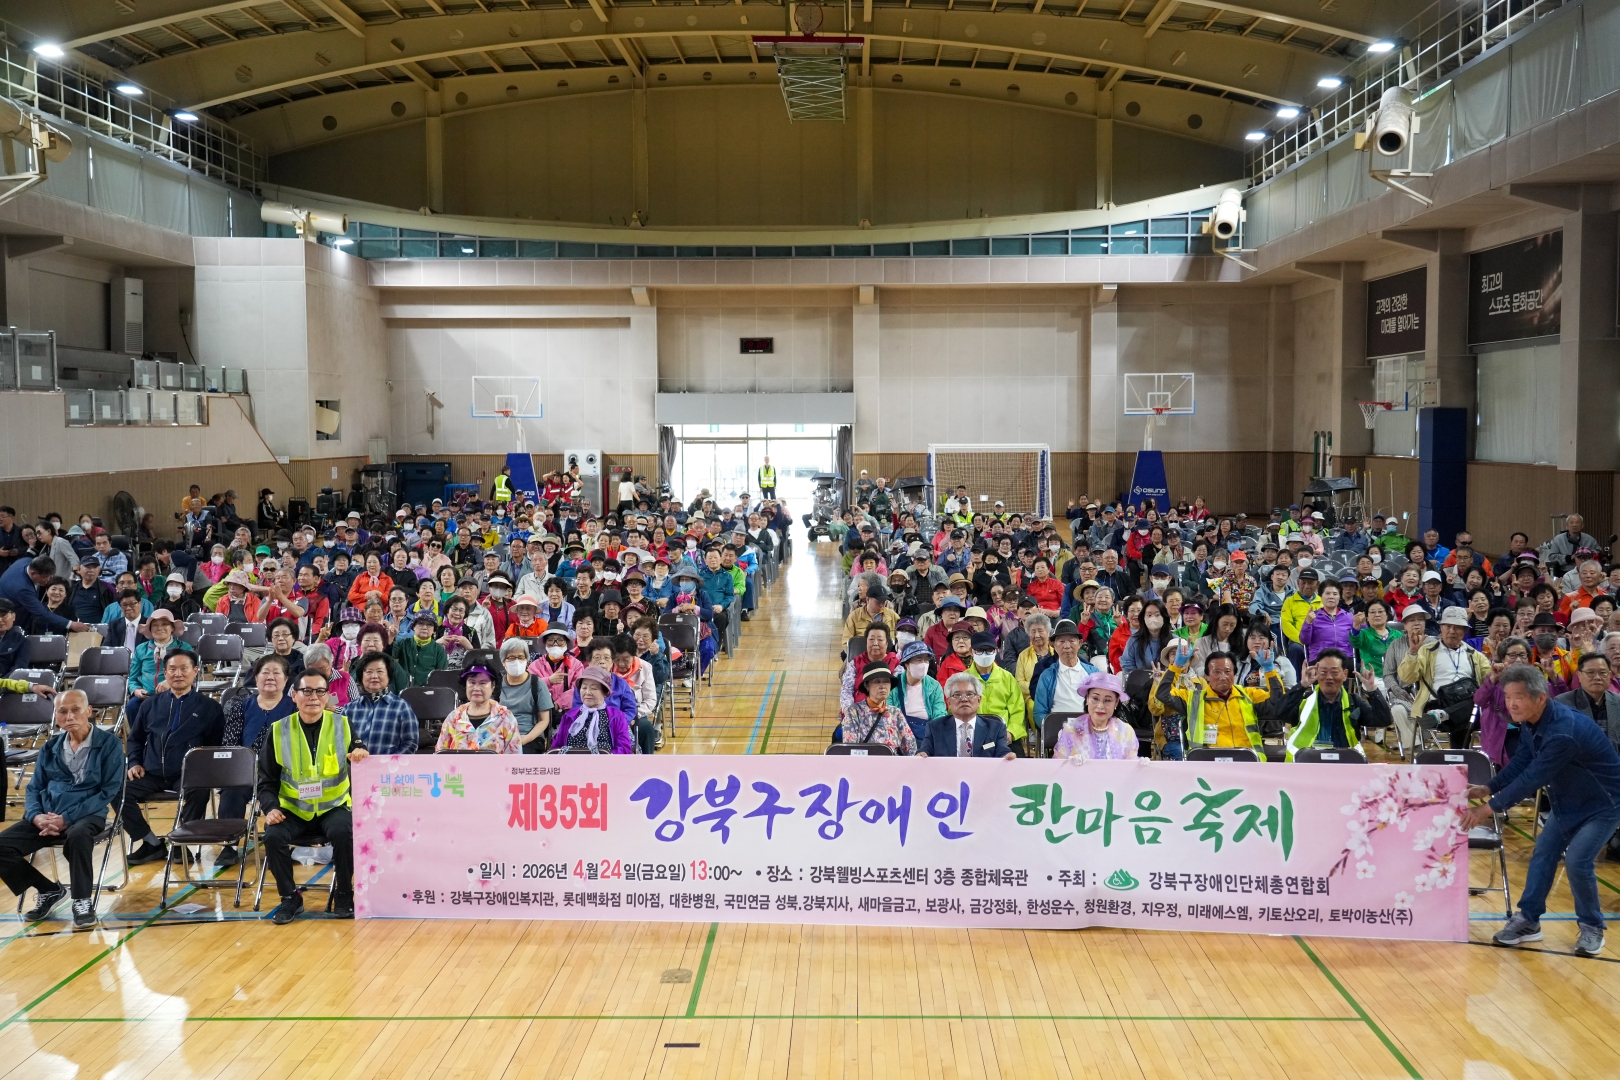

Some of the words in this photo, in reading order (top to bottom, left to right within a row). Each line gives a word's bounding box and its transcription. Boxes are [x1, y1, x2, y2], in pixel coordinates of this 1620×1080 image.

[1481, 271, 1503, 293] 최고의
[1375, 297, 1391, 315] 고객의
[1391, 292, 1408, 313] 건강한
[1488, 294, 1511, 316] 스포츠
[1512, 288, 1543, 313] 문화공간
[1380, 316, 1397, 334] 미래를
[1397, 312, 1420, 333] 열어가는
[380, 774, 391, 785] 내
[394, 774, 415, 785] 삶에
[511, 767, 561, 776] 정부보조금사업
[418, 772, 465, 798] 강북
[507, 782, 608, 832] 제35회
[1009, 777, 1294, 862] 한마음축제
[479, 862, 506, 880] 일시
[522, 863, 568, 880] 2026년
[690, 860, 743, 881] 13:00~
[766, 865, 793, 883] 장소
[809, 865, 929, 886] 강북웰빙스포츠센터
[933, 867, 956, 887] 3층
[960, 868, 1029, 887] 종합체육관
[1057, 869, 1086, 888] 주최
[1148, 871, 1331, 897] 강북구장애인단체총연합회
[411, 889, 436, 905] 후원
[450, 890, 559, 907] 강북구장애인복지관,
[562, 891, 622, 908] 롯데백화점
[626, 892, 665, 909] 미아점,
[669, 892, 720, 910] 대한병원,
[723, 893, 771, 910] 국민연금
[857, 896, 921, 914] 새마을금고,
[925, 897, 965, 915] 보광사,
[969, 898, 1022, 916] 금강정화,
[1026, 898, 1079, 916] 한성운수,
[1083, 898, 1136, 917] 청원환경,
[1141, 901, 1182, 919] 지우정,
[1257, 906, 1324, 924] 키토산오리,
[1327, 907, 1414, 926] 토박이농산(주)
